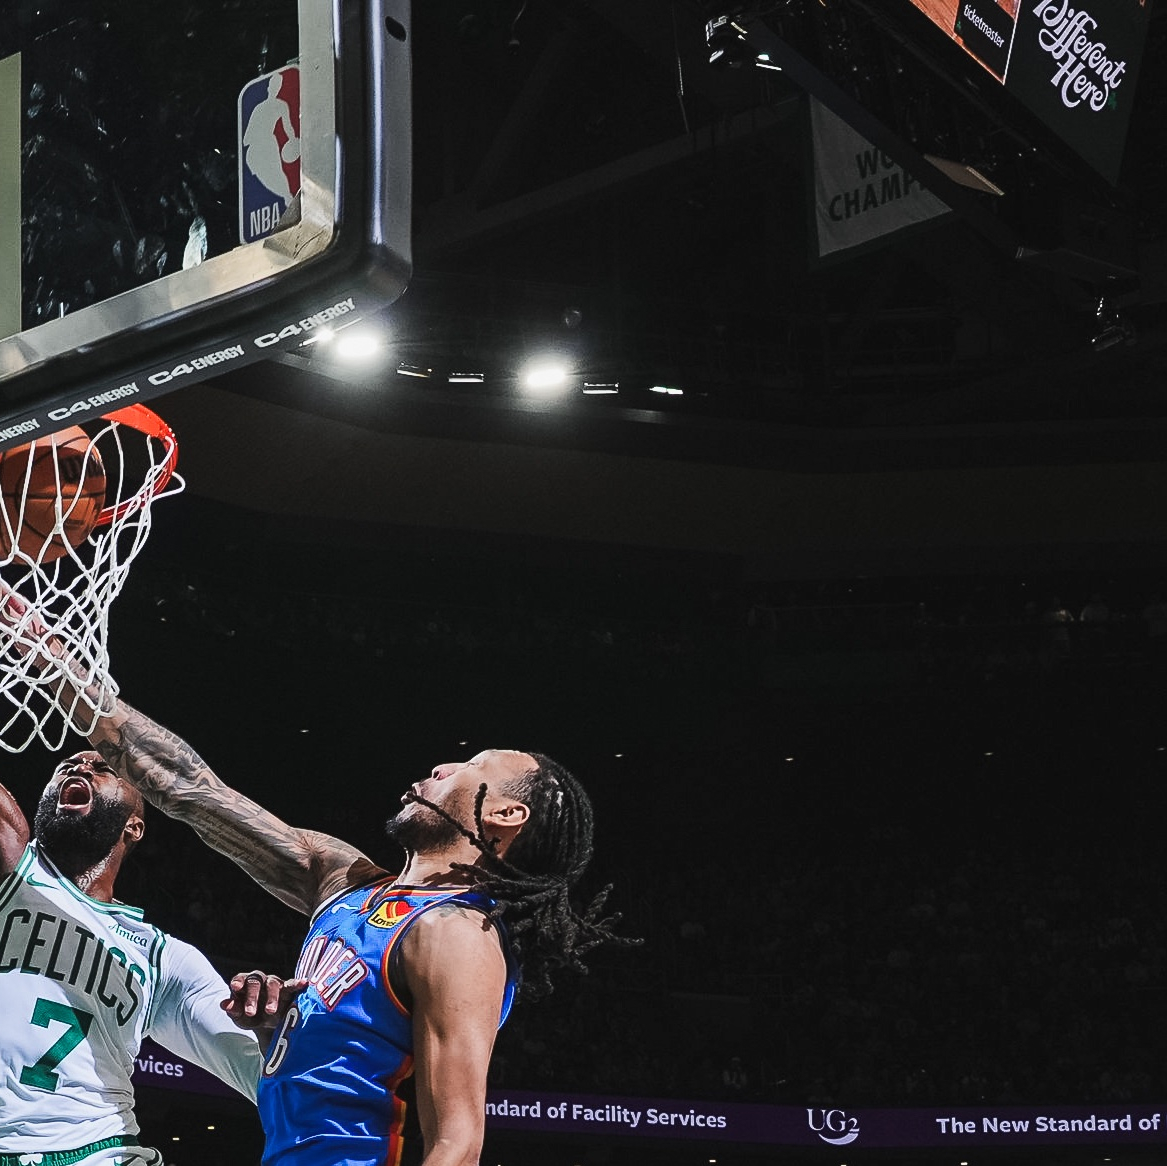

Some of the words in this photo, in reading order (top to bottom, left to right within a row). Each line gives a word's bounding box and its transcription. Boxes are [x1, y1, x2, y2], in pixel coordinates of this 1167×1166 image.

[964, 4, 1005, 48] ticketmaster
[1050, 54, 1109, 112] Here
[829, 170, 914, 221] CHAMP
[250, 202, 280, 238] NBA
[88, 382, 140, 407] ENERGY
[191, 345, 245, 370] ENERGY
[299, 298, 356, 332] ENERGY
[108, 922, 148, 948] Amica
[19, 998, 94, 1092] 7
[263, 1006, 300, 1078] 6
[138, 1055, 184, 1077] vices
[485, 1100, 541, 1118] ndard
[547, 1103, 568, 1119] of
[573, 1105, 642, 1128] Facility
[647, 1109, 727, 1128] Services
[806, 1108, 860, 1133] UG2
[936, 1117, 976, 1134] The
[983, 1117, 1030, 1133] New
[1036, 1115, 1132, 1132] Standard
[1139, 1113, 1161, 1131] of
